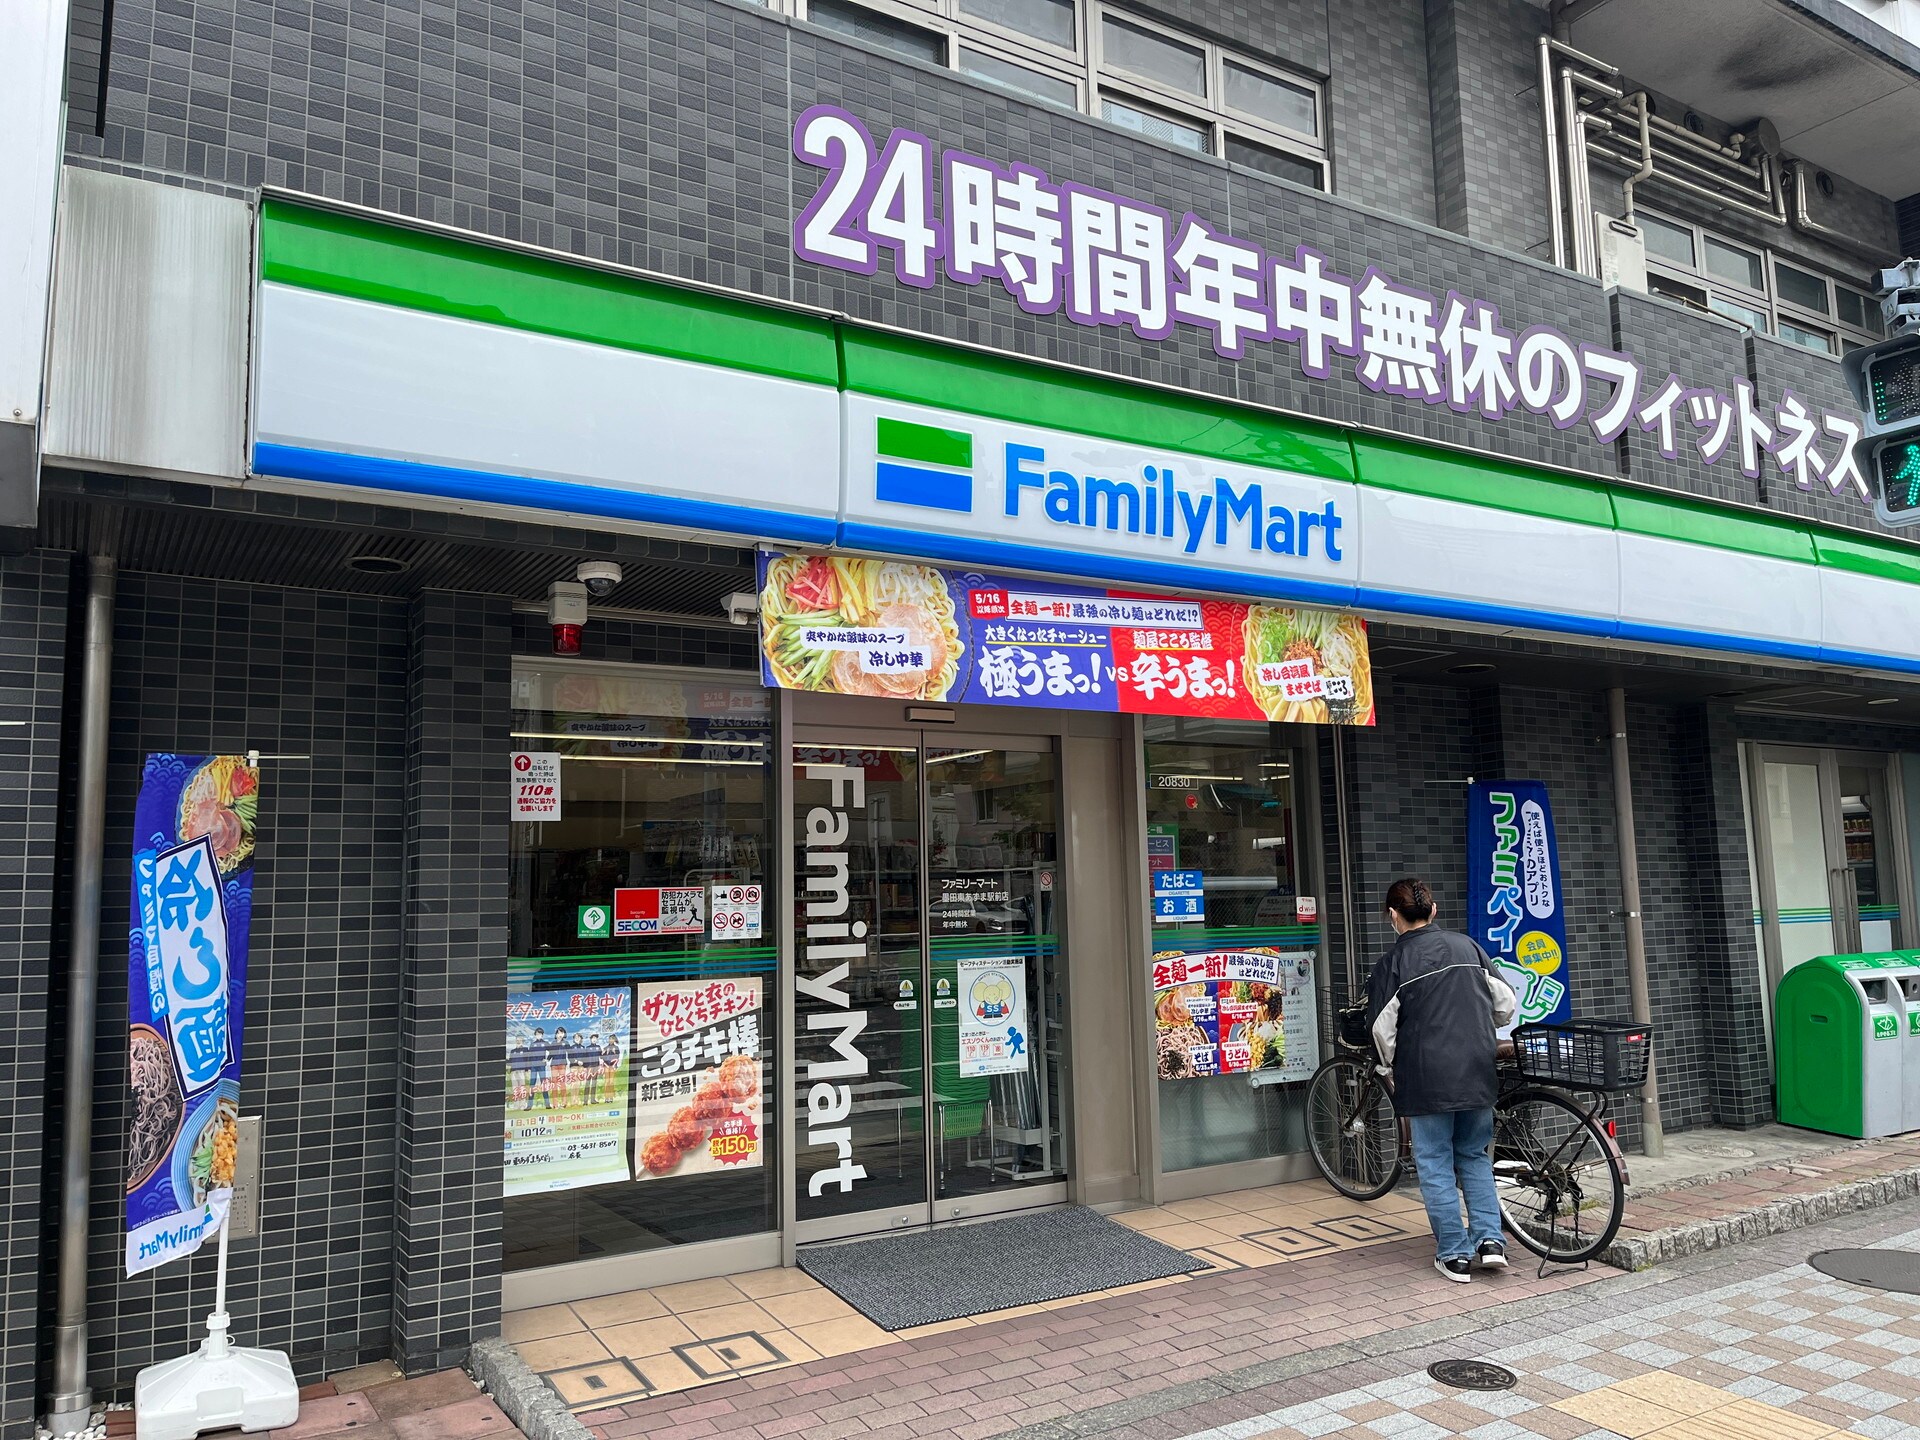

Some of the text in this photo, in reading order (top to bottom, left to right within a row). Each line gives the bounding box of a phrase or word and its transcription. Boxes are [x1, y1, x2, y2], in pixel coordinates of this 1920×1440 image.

[800, 115, 1870, 498] 24時間年中無休のフィットネス
[1005, 442, 1342, 562] FamilyMart
[975, 593, 1000, 604] 5/16
[1010, 599, 1198, 623] 全麺一新! 最強の冷し麺はどれだ!?
[805, 631, 905, 644] 爽やかな酸味のスープ
[984, 624, 1107, 644] 大きくなったチャーシュー
[1133, 630, 1212, 649] 麺屋こころ監修
[869, 651, 924, 668] 冷し中華
[978, 645, 1101, 698] 極うまっ!
[1130, 652, 1236, 700] 辛うまっ!
[1262, 664, 1310, 681] 冷し台湾風
[1286, 680, 1321, 696] まぜそば
[520, 785, 554, 796] 110番
[1158, 776, 1190, 788] 20830
[1530, 811, 1550, 908] 使えば使うほどおトクな
[1162, 873, 1195, 888] たばこ
[1489, 793, 1522, 951] ファミペイ
[942, 878, 998, 889] ファミリーマート
[661, 891, 703, 899] 防犯カメラで
[662, 899, 692, 907] セコムが
[618, 920, 657, 931] SECOM
[1526, 939, 1546, 951] 会員
[1153, 954, 1274, 988] 全麺一新! 最強の冷し麺
[796, 766, 868, 1198] FamilyMart
[642, 982, 736, 1022] ザクッと衣の
[659, 990, 755, 1037] ひとくちチキン!
[641, 1014, 760, 1078] ころチキ棒
[1228, 1050, 1249, 1059] うどん
[1194, 1051, 1209, 1062] そば
[641, 1073, 697, 1102] 新登場!
[720, 1136, 755, 1155] 150円
